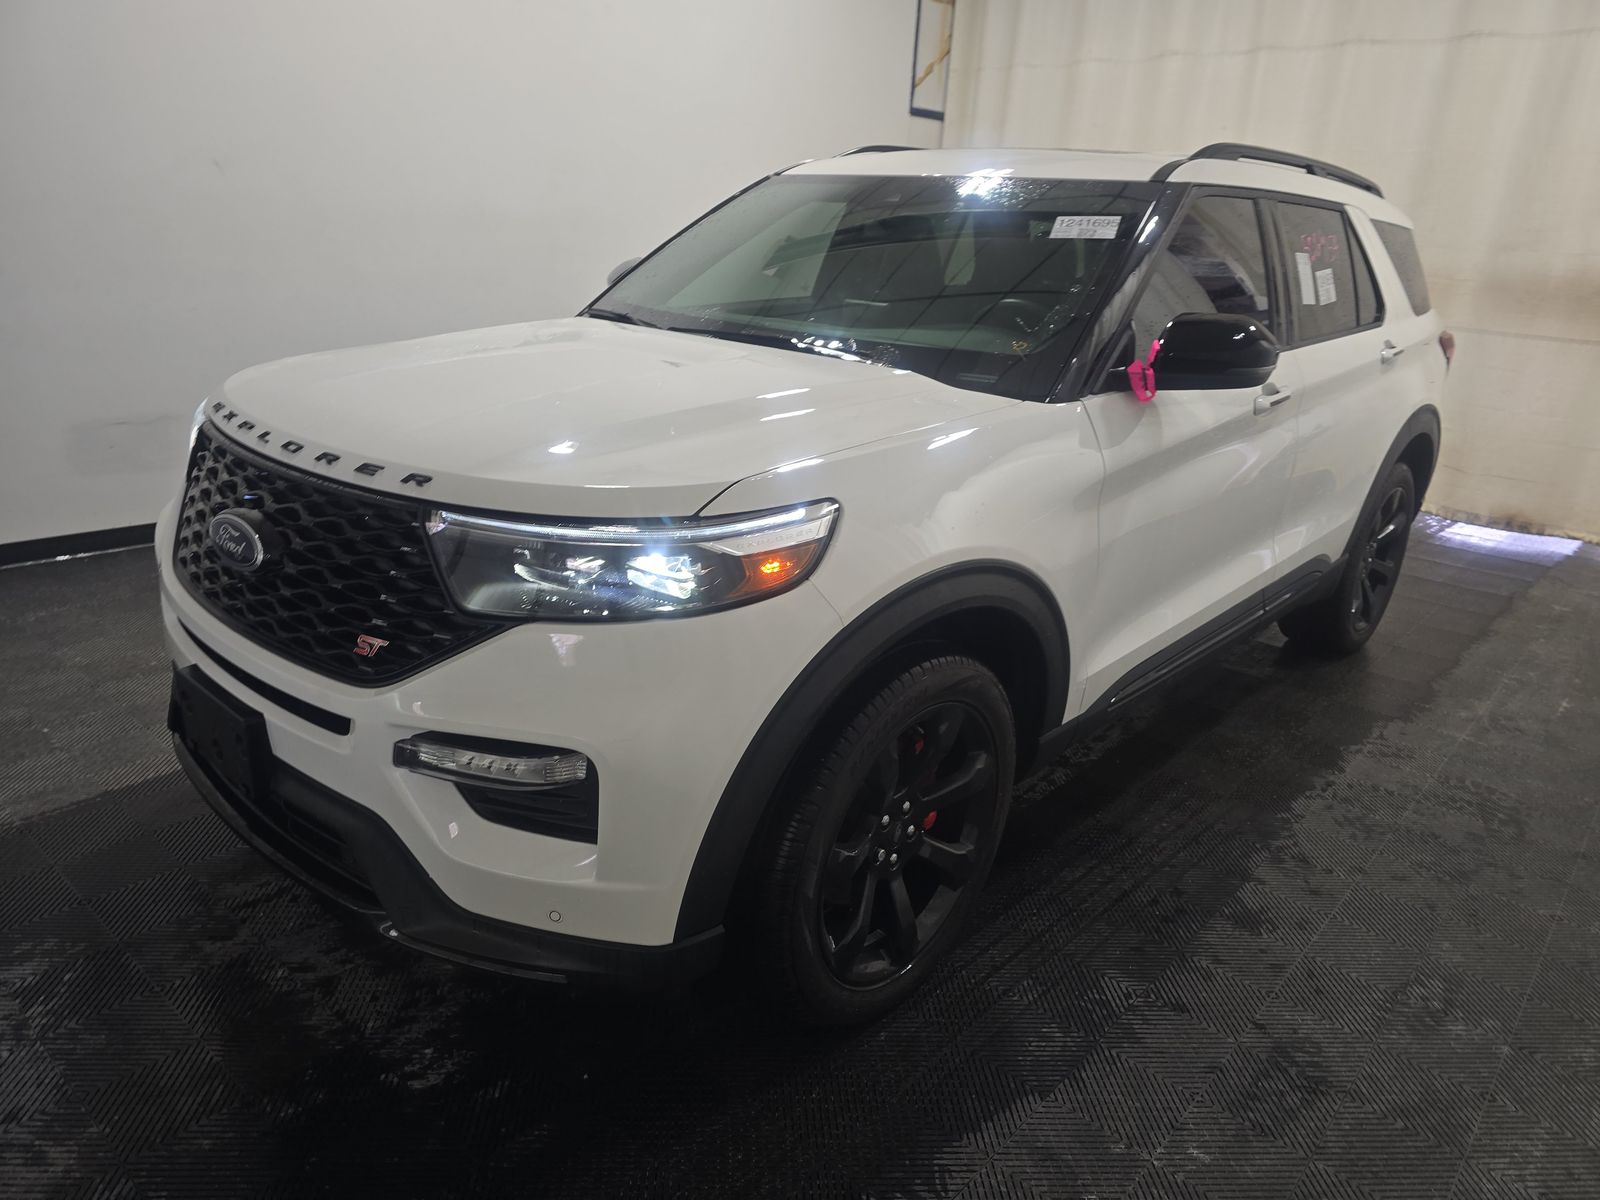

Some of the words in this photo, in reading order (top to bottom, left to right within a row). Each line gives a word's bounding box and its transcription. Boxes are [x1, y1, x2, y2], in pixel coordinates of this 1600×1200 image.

[1058, 218, 1120, 228] 1241695
[212, 401, 433, 487] EXPLORER
[215, 523, 248, 556] Ford
[352, 633, 390, 658] ST
